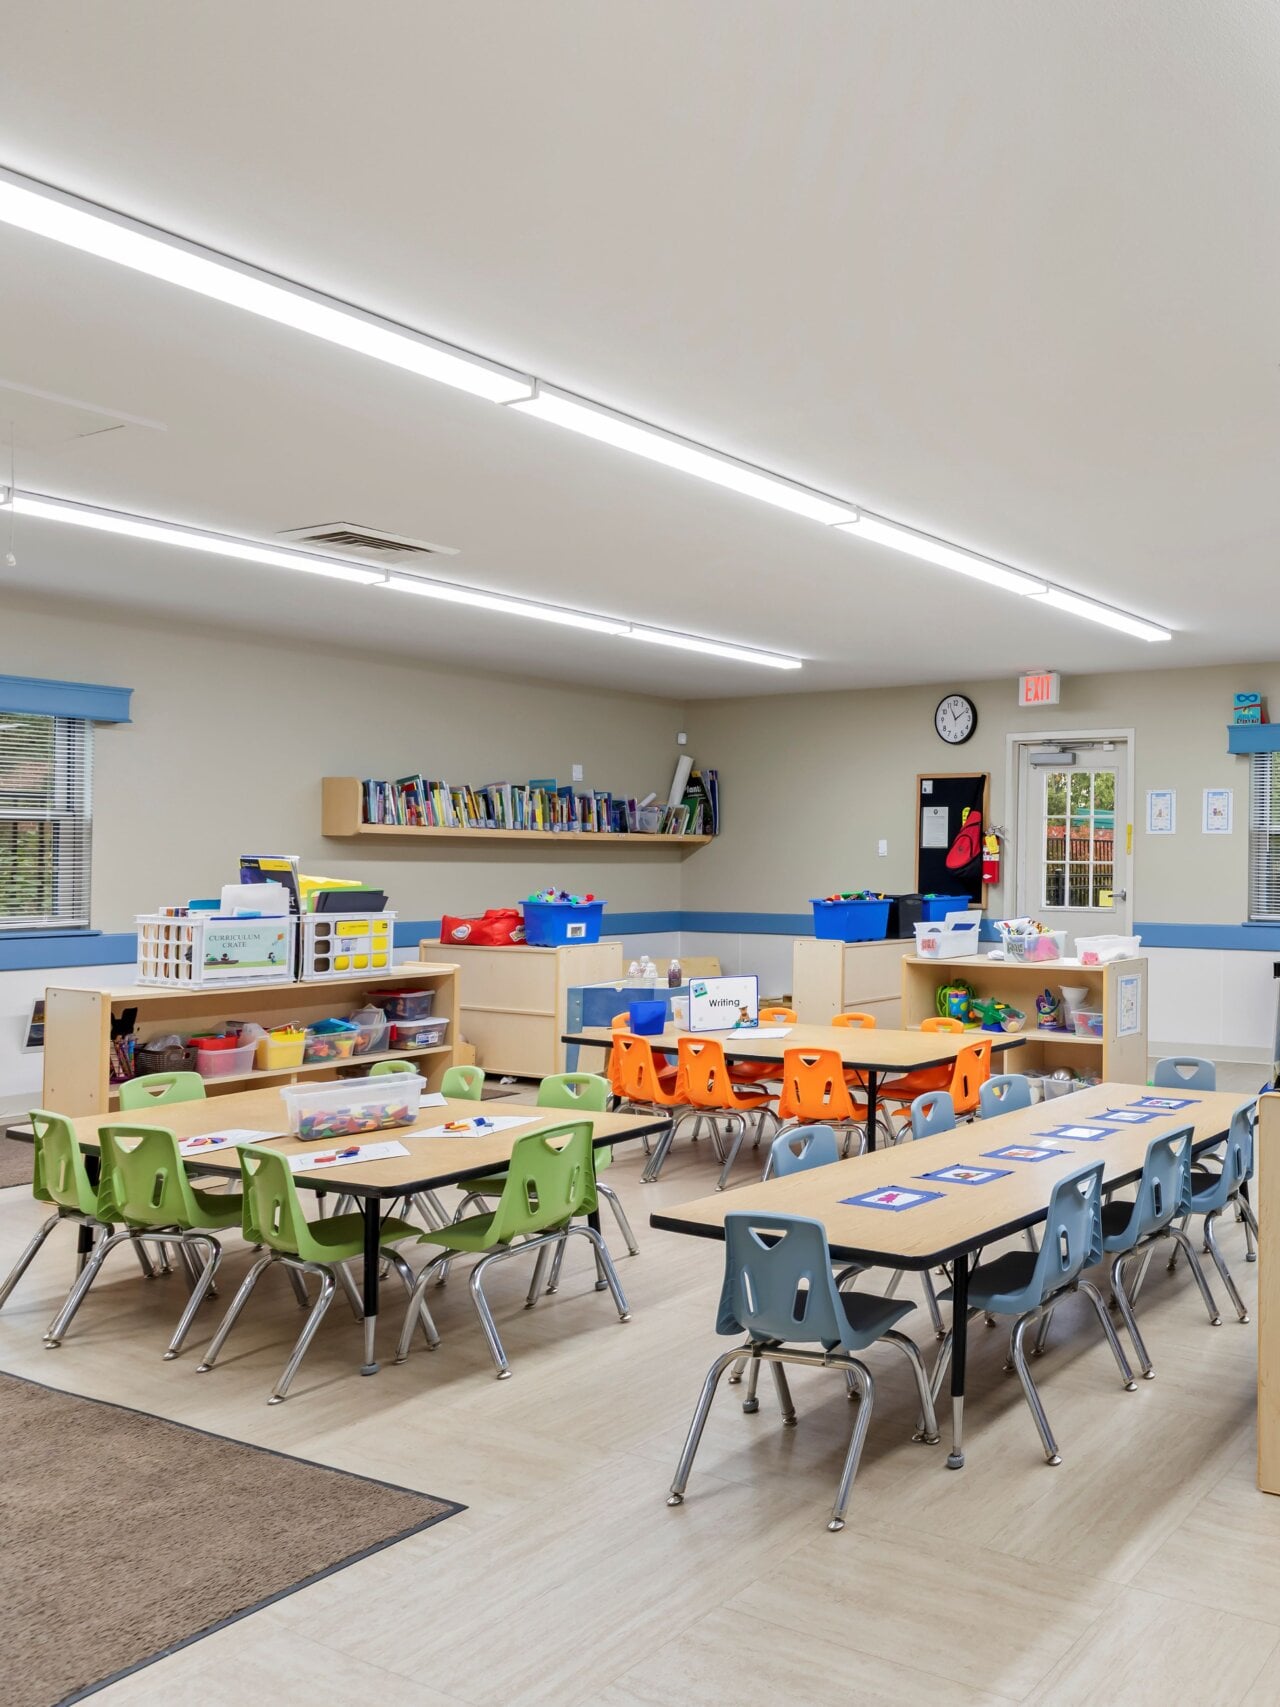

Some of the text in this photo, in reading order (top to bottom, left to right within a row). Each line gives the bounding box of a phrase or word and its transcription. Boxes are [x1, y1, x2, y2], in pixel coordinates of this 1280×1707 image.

[1025, 675, 1052, 703] EXIT
[208, 933, 261, 942] CURRICULUM
[222, 941, 247, 949] CRATE
[709, 998, 740, 1008] Writing
